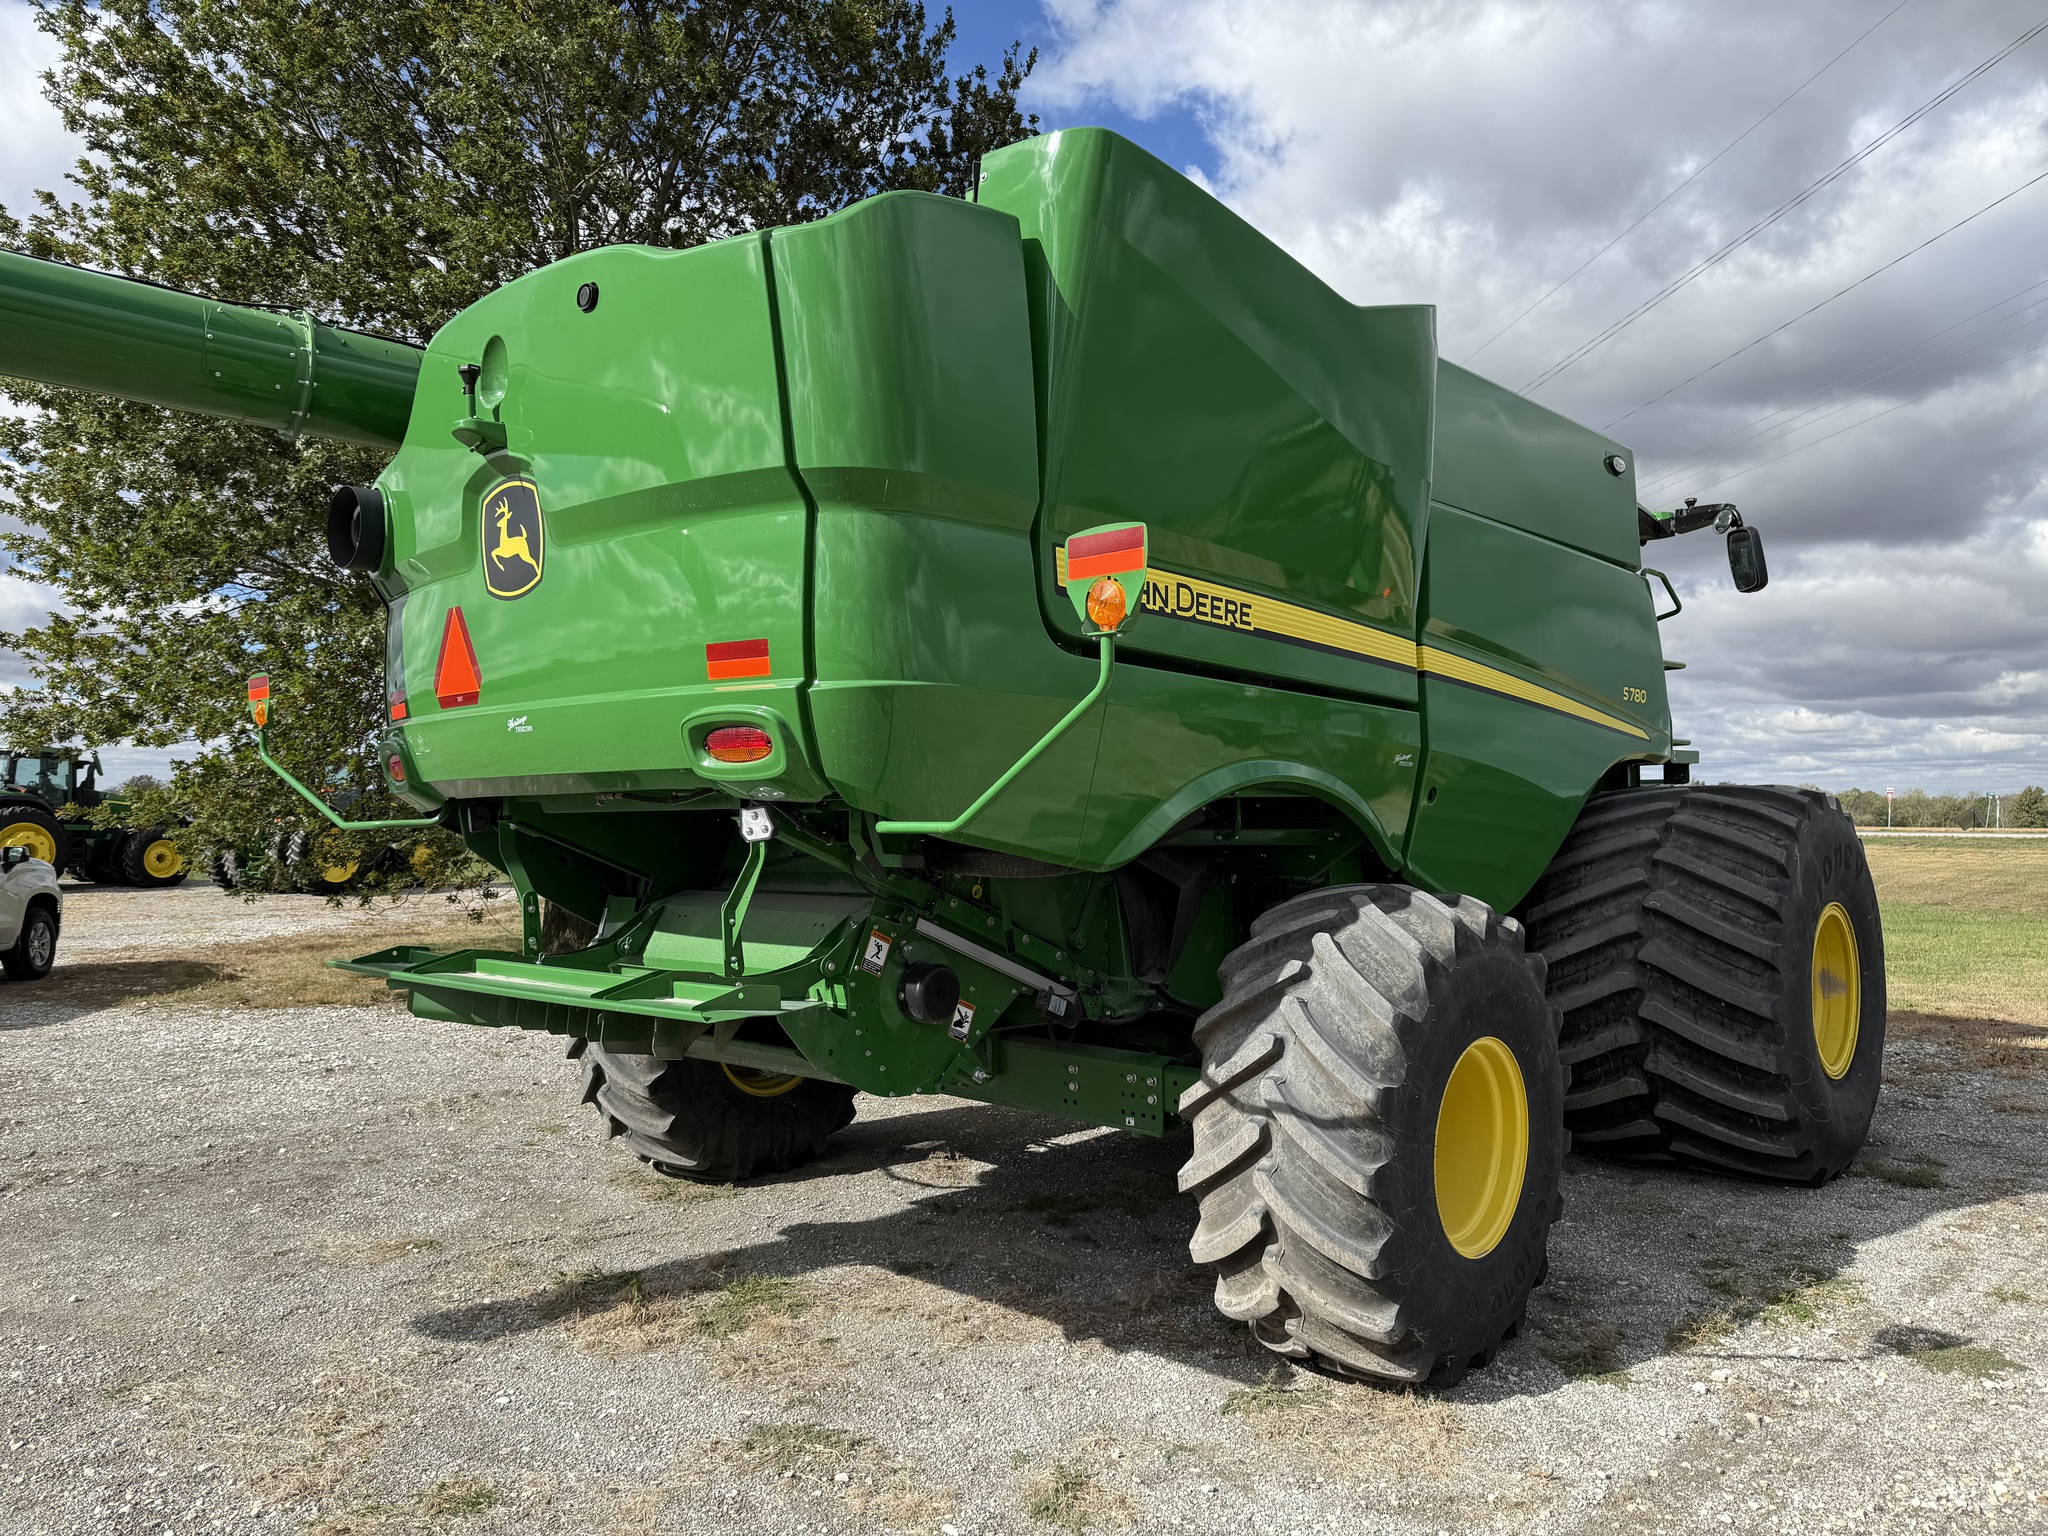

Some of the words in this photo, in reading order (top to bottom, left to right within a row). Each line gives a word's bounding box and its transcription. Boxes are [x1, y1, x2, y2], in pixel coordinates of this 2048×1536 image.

[1141, 580, 1169, 610] HN
[1176, 581, 1253, 628] DEERE
[1623, 686, 1647, 704] S780
